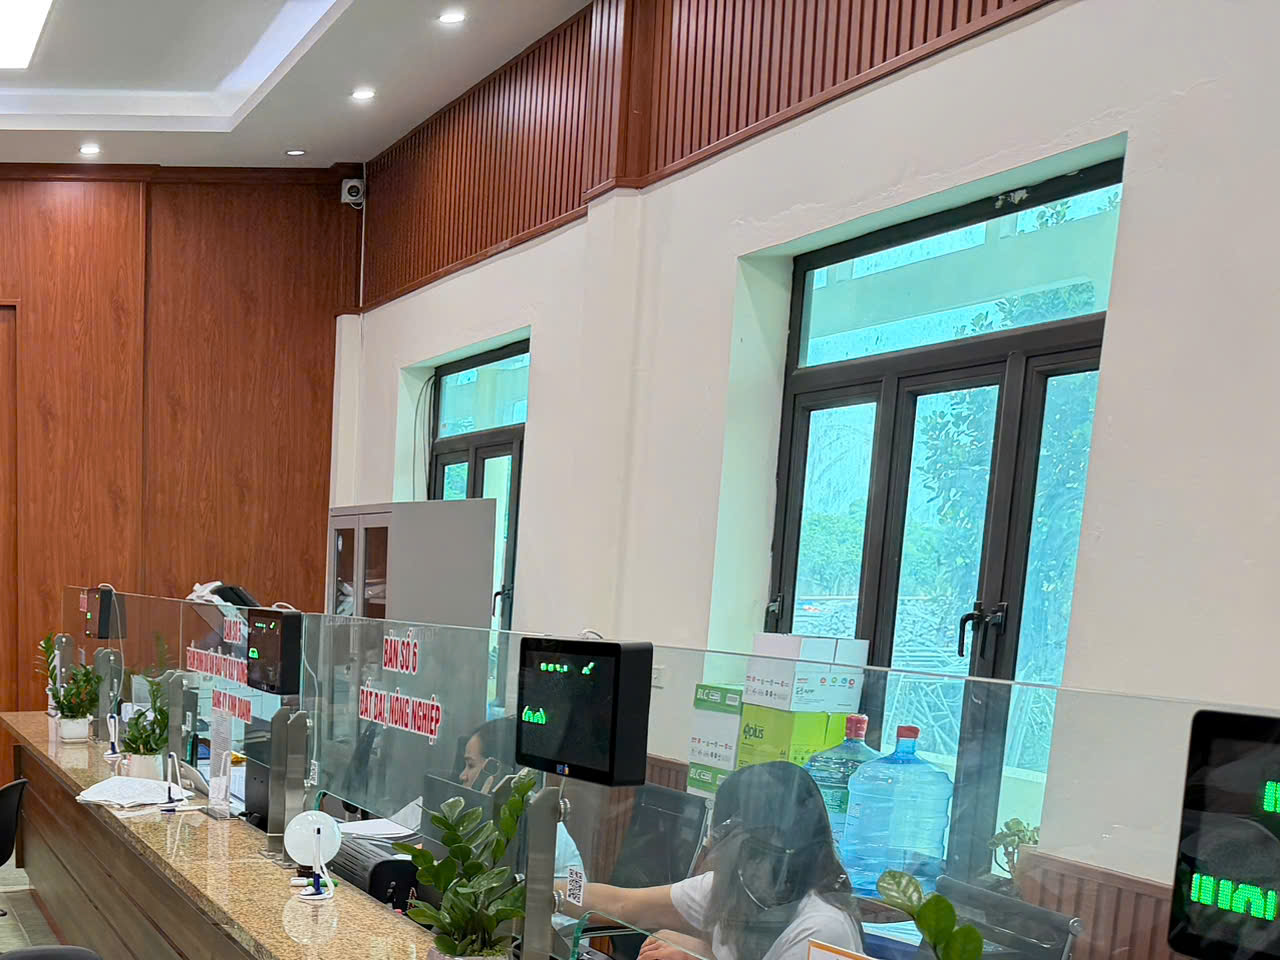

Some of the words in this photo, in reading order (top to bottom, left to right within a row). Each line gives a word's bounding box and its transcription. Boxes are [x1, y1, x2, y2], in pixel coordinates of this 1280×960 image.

[383, 629, 400, 672] BÀN
[400, 627, 413, 674] SỐ
[411, 639, 419, 675] 6
[388, 687, 410, 731] NÔNG
[410, 694, 442, 745] NGHIỆP
